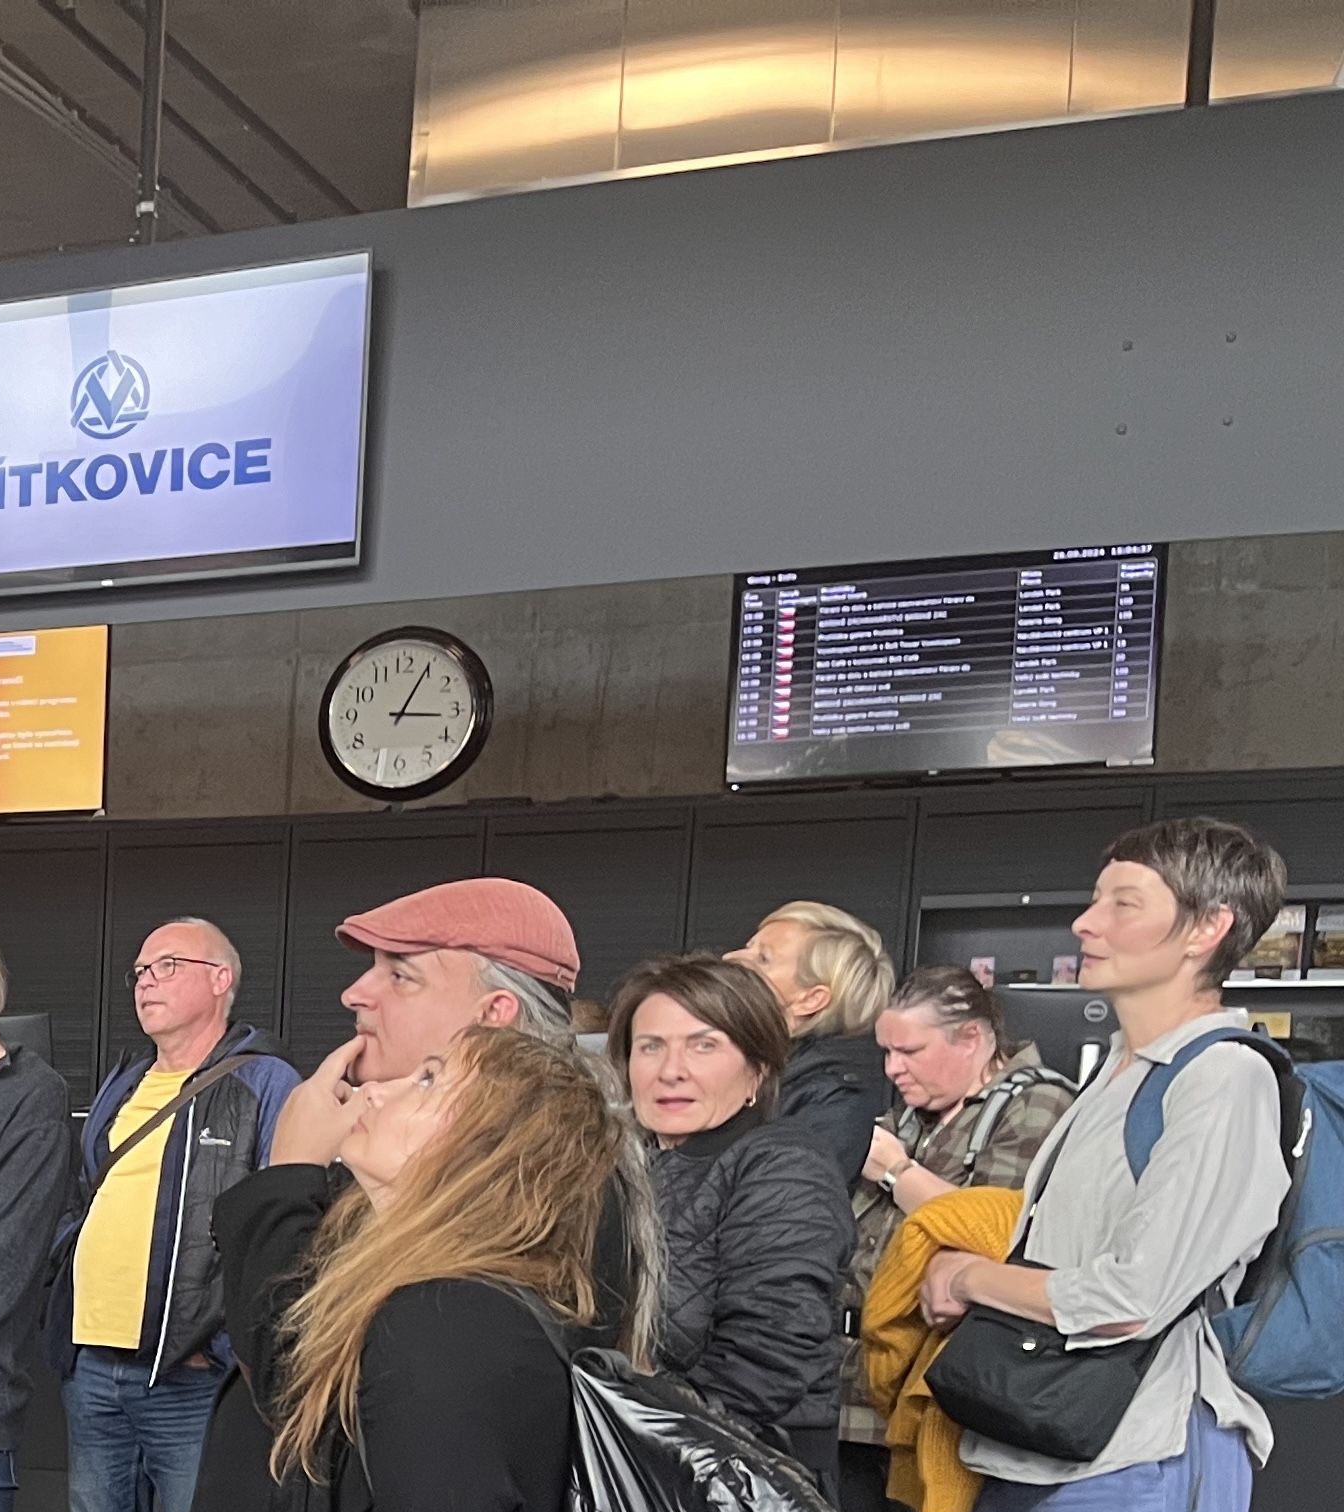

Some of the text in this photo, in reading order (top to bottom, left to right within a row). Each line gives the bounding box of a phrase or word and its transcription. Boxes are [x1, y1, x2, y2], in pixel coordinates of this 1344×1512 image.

[396, 656, 414, 674] 12
[374, 666, 388, 683] 11
[440, 675, 451, 693] 2
[356, 686, 373, 703] 10
[346, 708, 357, 725] 9
[449, 701, 460, 718] 3
[352, 732, 365, 750] 8
[438, 726, 451, 743] 4
[394, 753, 405, 774] 6
[422, 745, 433, 767] 5
